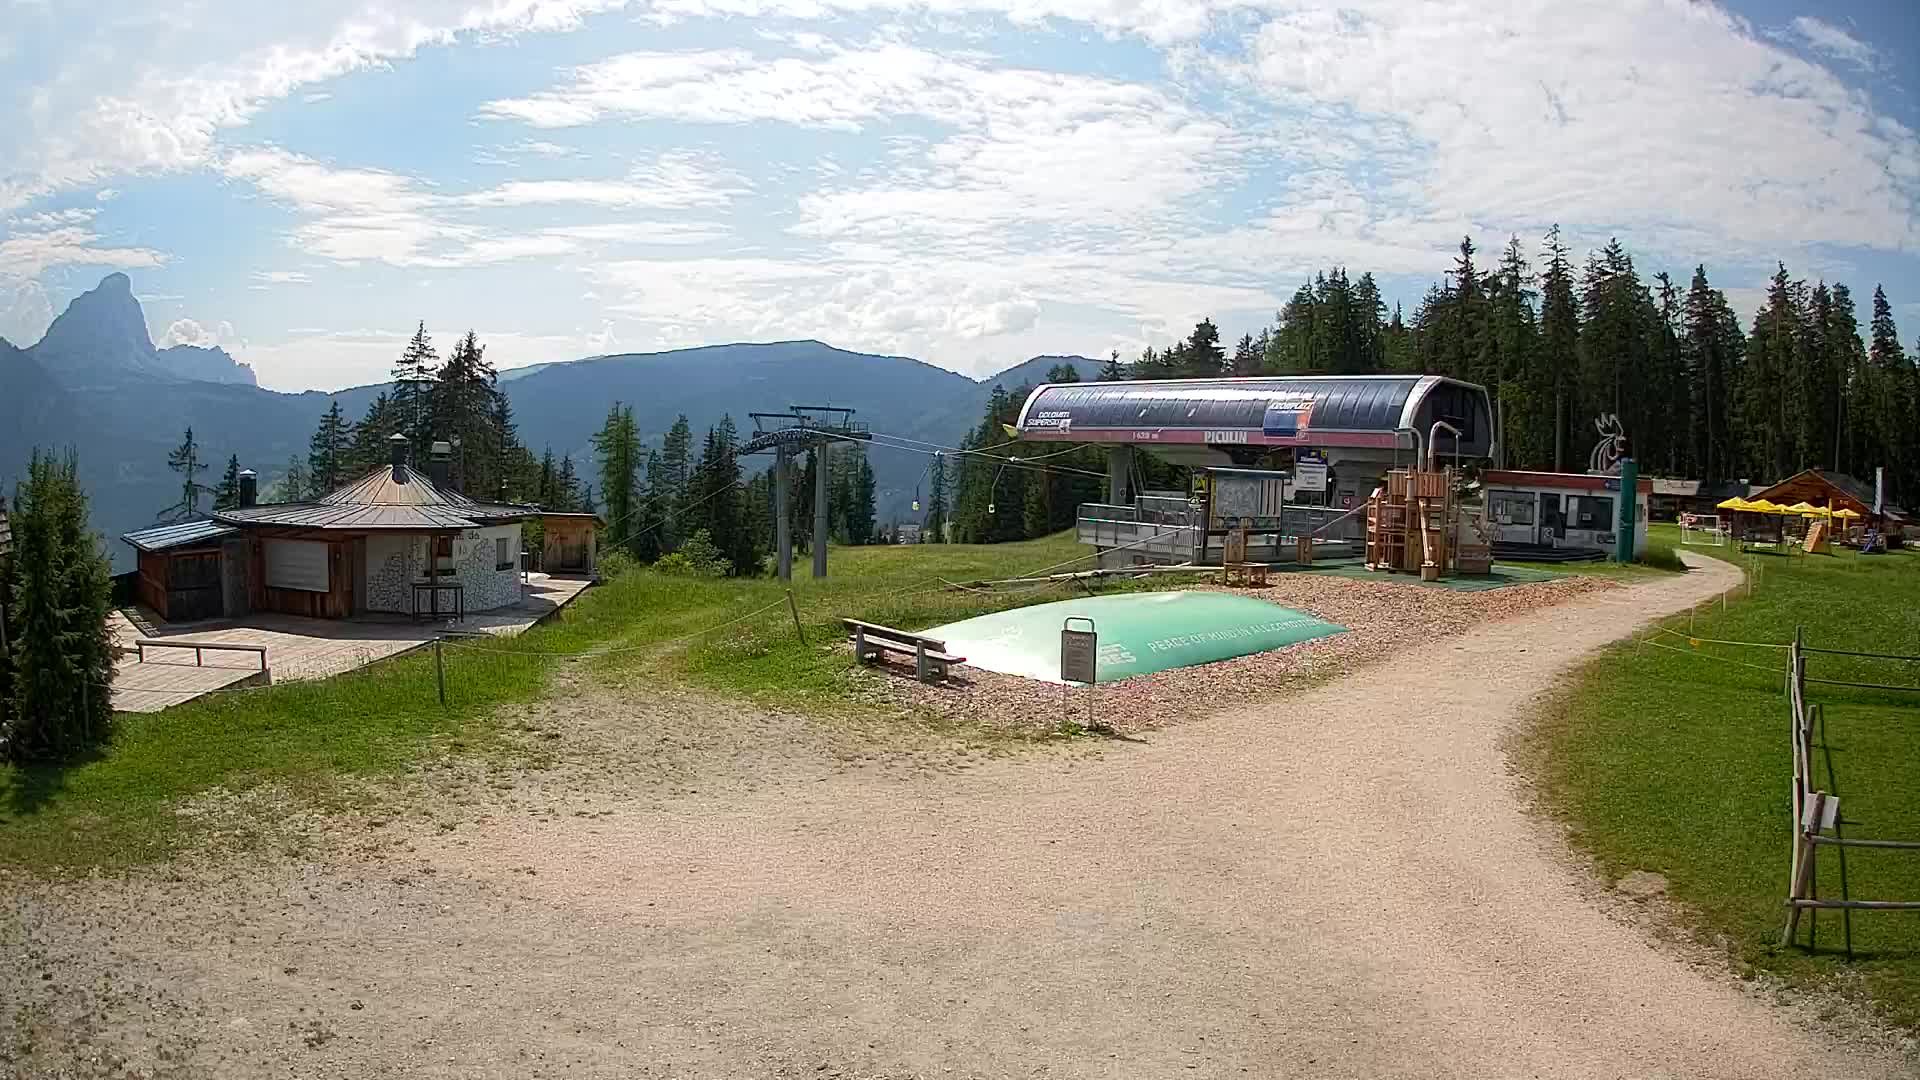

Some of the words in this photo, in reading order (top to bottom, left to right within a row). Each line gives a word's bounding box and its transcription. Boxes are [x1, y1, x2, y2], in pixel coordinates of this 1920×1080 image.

[1204, 431, 1248, 443] PICULIN
[1147, 636, 1190, 653] PEACE
[1191, 633, 1206, 644] OF
